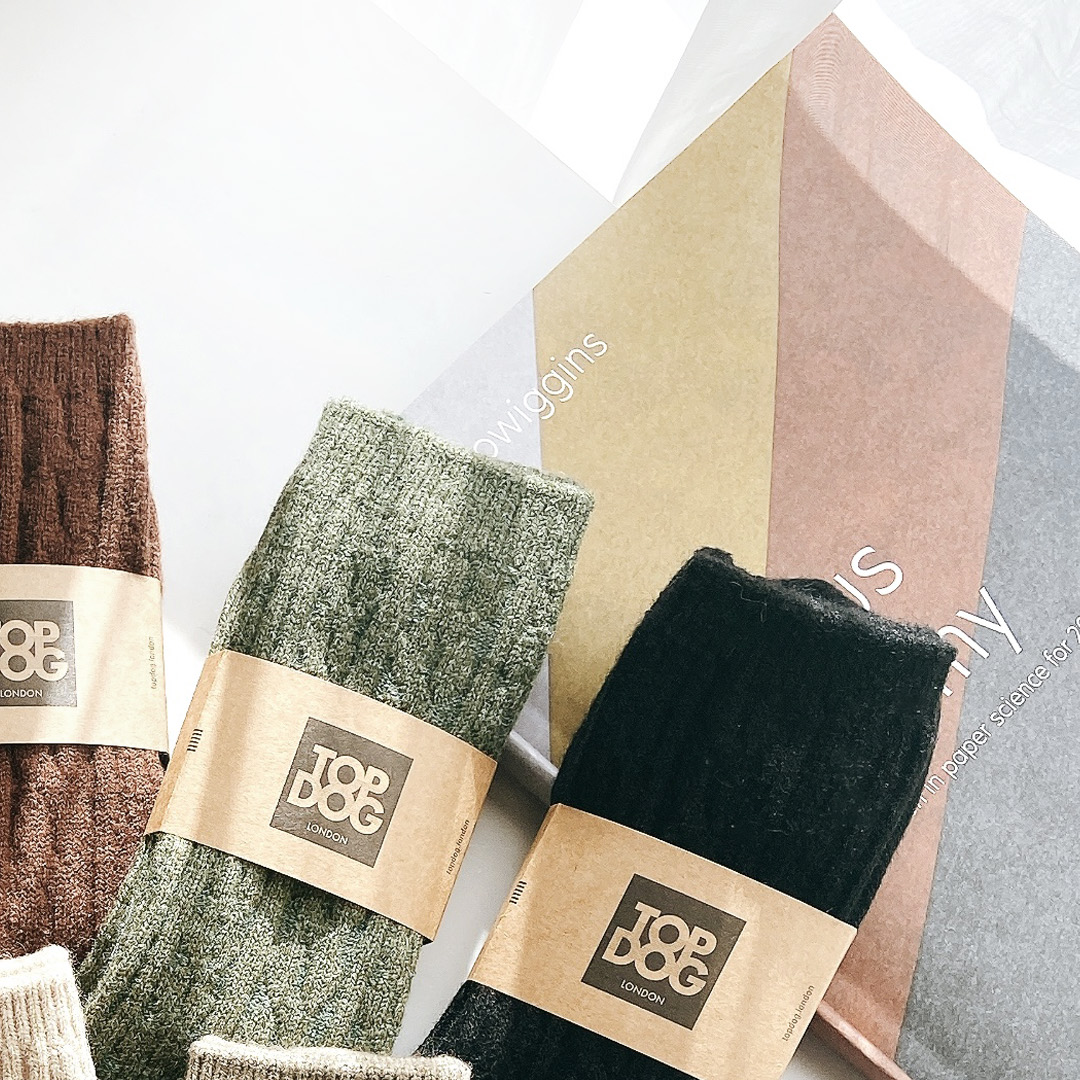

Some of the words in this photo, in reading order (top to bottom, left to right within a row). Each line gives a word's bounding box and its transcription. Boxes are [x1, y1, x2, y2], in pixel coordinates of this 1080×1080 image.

[0, 688, 44, 699] LONDON
[941, 723, 993, 780] paper
[989, 664, 1052, 727] science
[1041, 640, 1074, 668] for
[313, 743, 391, 797] TOP
[286, 768, 386, 835] DOG
[306, 821, 350, 846] LONDON
[632, 901, 718, 957] TOP
[601, 926, 710, 997] DOG
[620, 979, 667, 1006] LONDON
